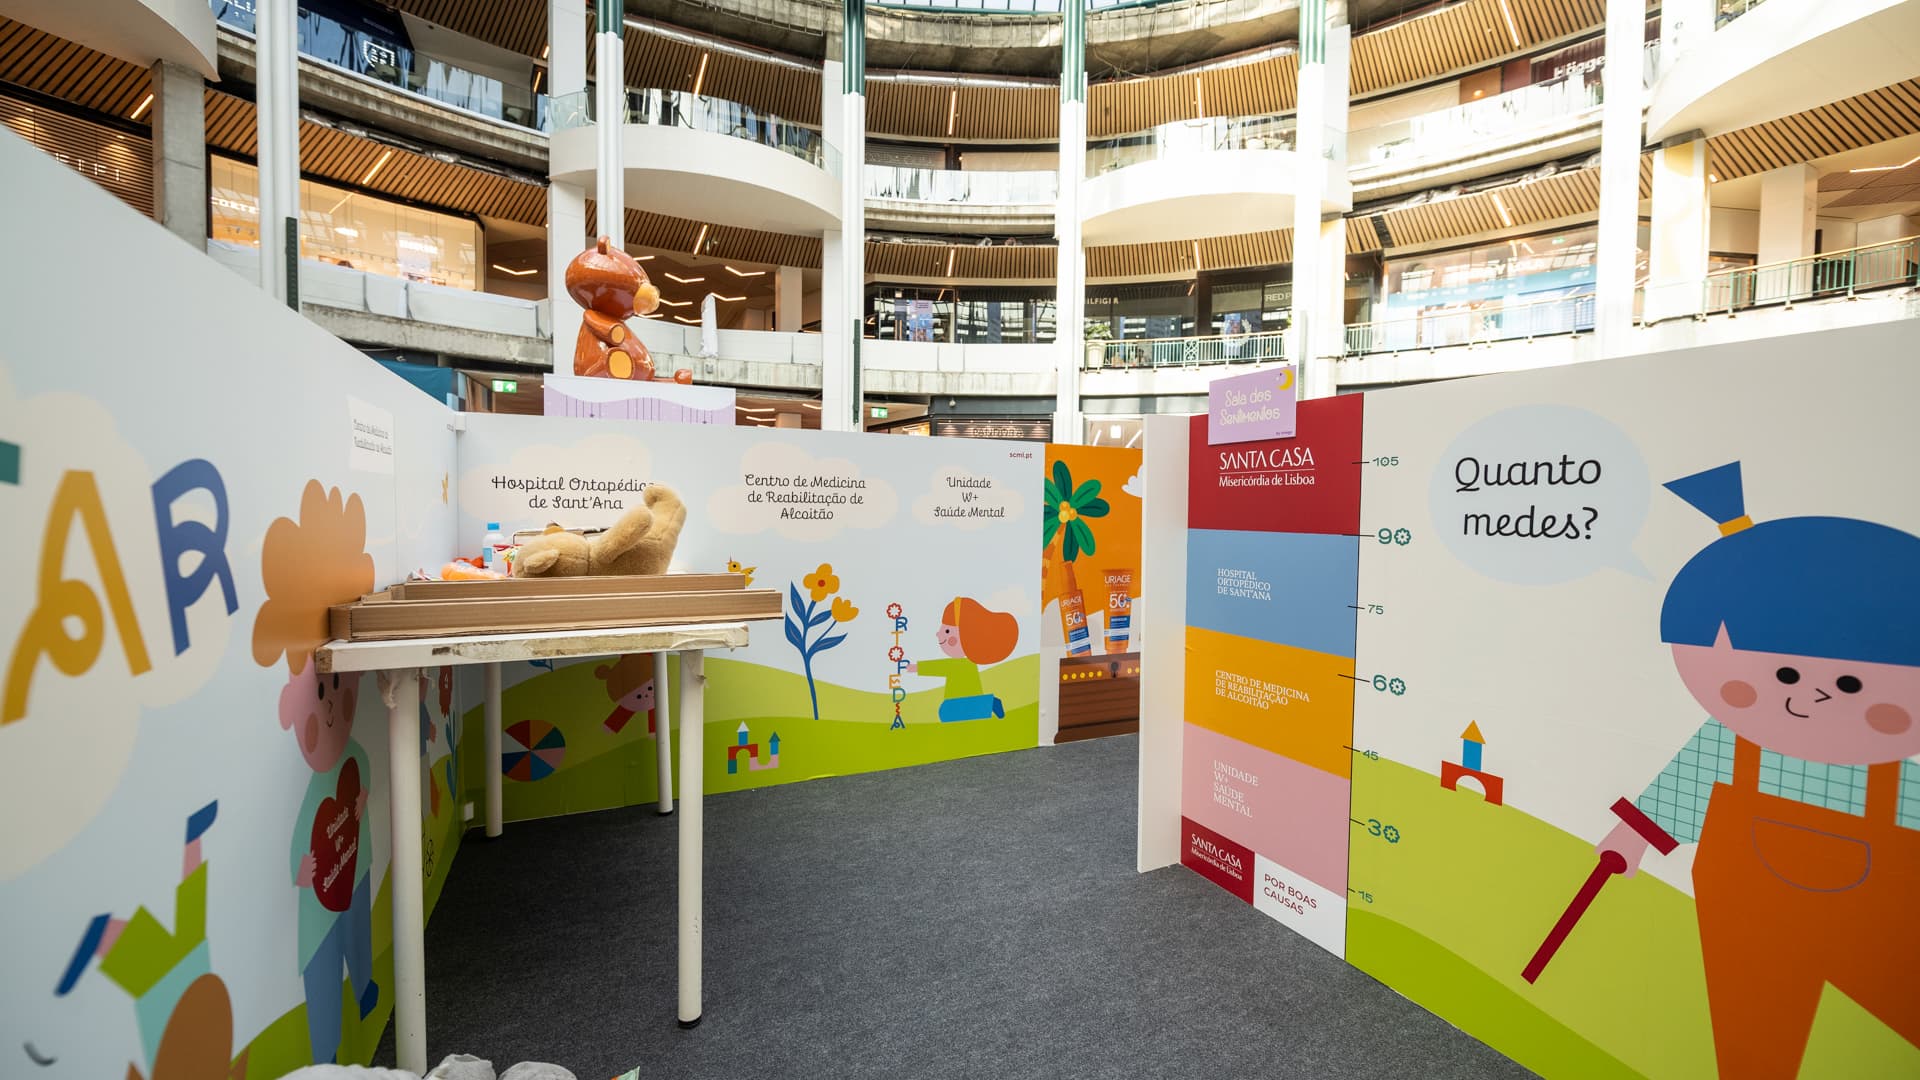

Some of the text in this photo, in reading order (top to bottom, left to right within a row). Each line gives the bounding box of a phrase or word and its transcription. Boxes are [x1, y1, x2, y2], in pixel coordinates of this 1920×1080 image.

[1225, 387, 1272, 407] Sala dos
[1009, 451, 1033, 459] scml.pt
[1220, 446, 1315, 470] SANTA CASA
[1373, 456, 1399, 467] 105
[745, 474, 866, 488] Centro de Medicina
[1219, 471, 1315, 487] Misericórdia de Lisboa
[1455, 454, 1602, 493] Quanto
[491, 476, 565, 493] Hospital
[946, 477, 992, 489] Unidade
[528, 496, 624, 510] de Sant'Ana
[747, 490, 864, 506] de Reabilitação de
[961, 492, 979, 503] W+
[780, 507, 834, 520] Alcoitão
[934, 506, 1005, 518] Saúde Mental
[1463, 505, 1599, 540] medes?
[1378, 528, 1412, 546] 90
[1104, 575, 1131, 584] URIAGE
[1217, 568, 1257, 580] HOSPITAL
[1217, 585, 1228, 595] DE
[1367, 604, 1384, 615] 75
[1216, 678, 1226, 689] DE
[1216, 670, 1310, 702] CENTRO DE MEDICINA
[1373, 674, 1407, 696] 60
[1216, 687, 1226, 697] DE
[1362, 750, 1379, 761] 45
[1214, 760, 1259, 786] UNIDADE
[1213, 791, 1253, 818] MENTAL
[1367, 819, 1400, 843] 30
[1192, 833, 1242, 870] SANTA CASA
[1264, 873, 1317, 909] POR BOAS
[1358, 890, 1373, 904] 15
[1264, 886, 1304, 915] CAUSAS
